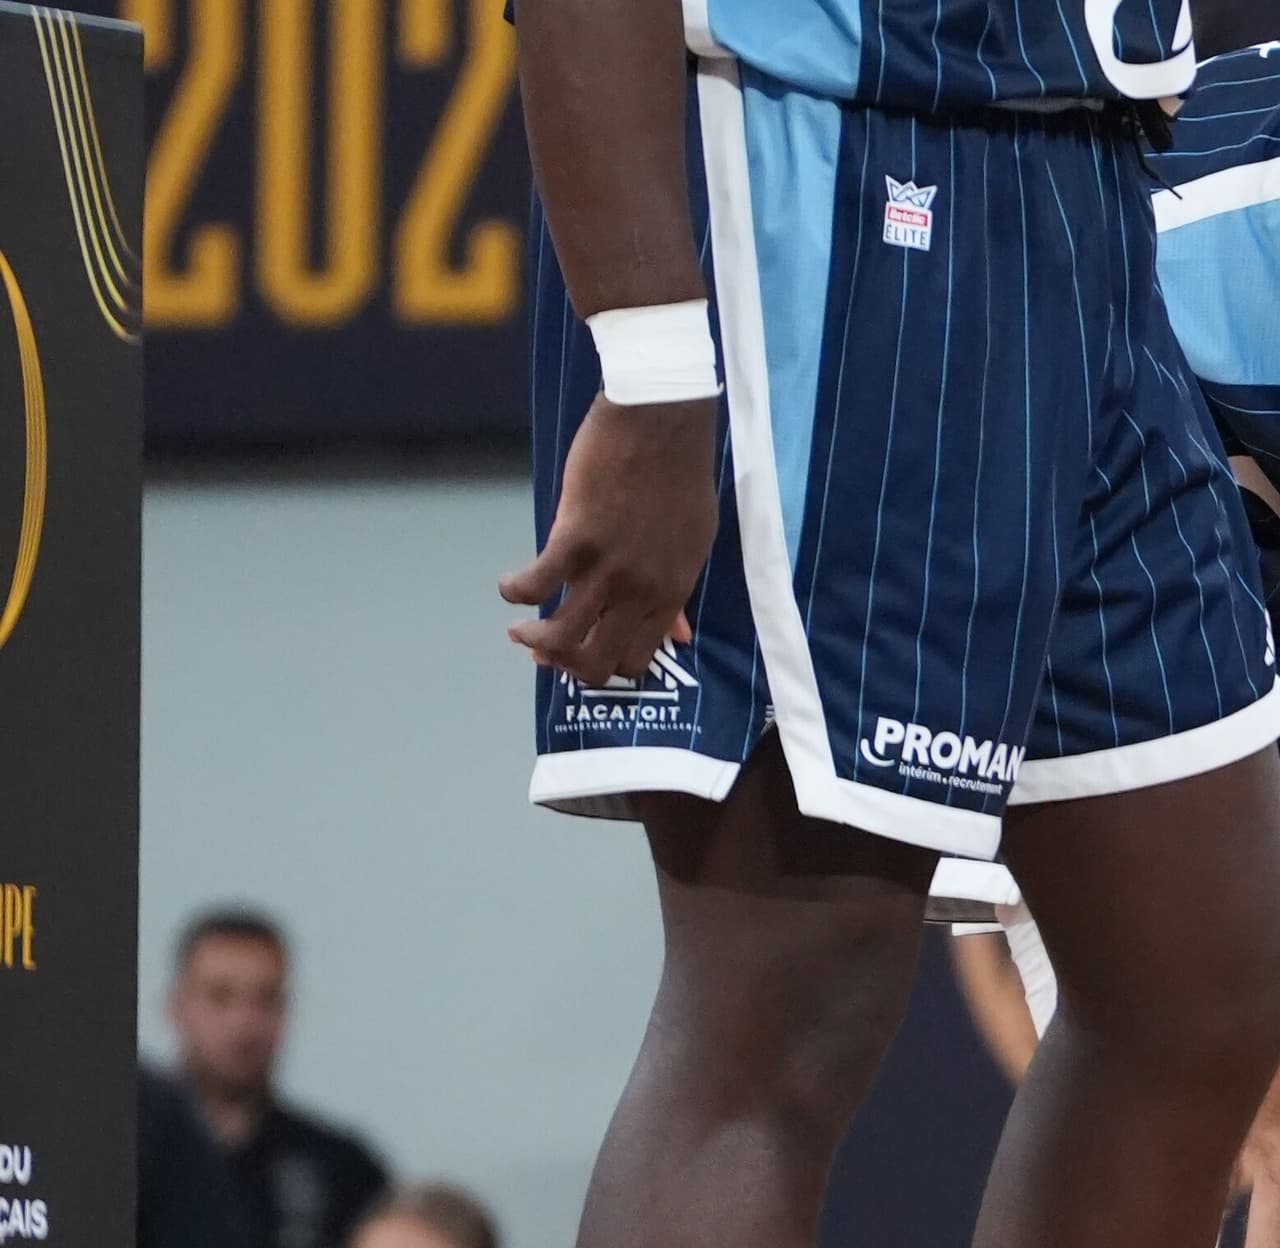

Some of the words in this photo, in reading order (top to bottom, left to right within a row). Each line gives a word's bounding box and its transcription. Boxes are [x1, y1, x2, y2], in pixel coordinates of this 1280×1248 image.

[565, 704, 681, 722] FACATOIT
[874, 716, 1026, 782] PROMAN
[899, 761, 941, 783] intérim
